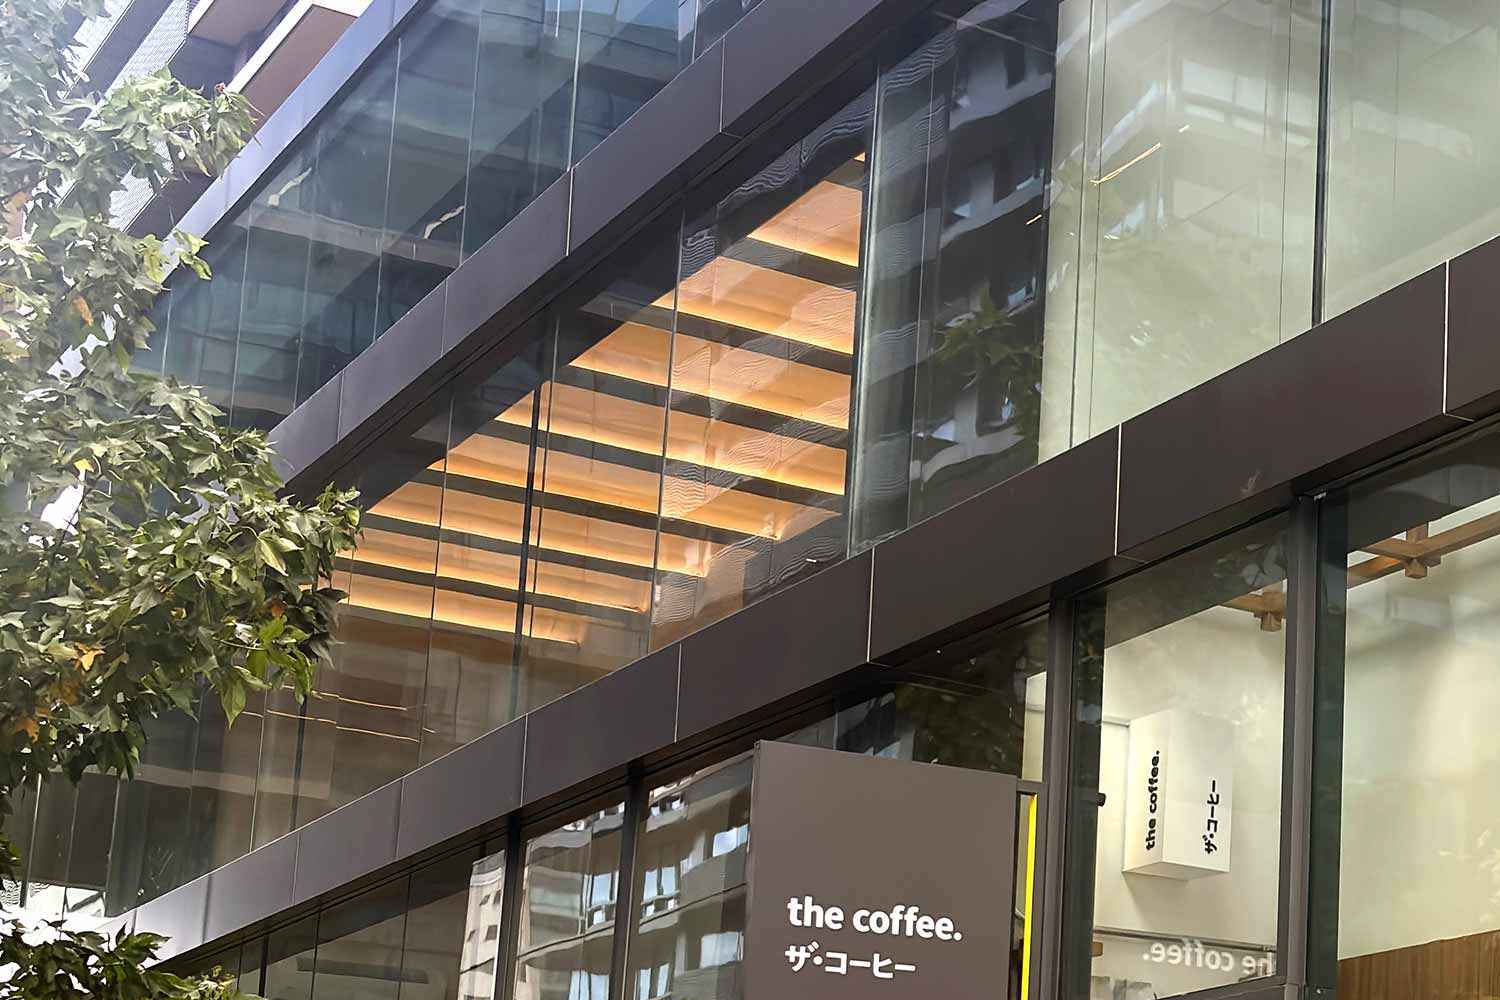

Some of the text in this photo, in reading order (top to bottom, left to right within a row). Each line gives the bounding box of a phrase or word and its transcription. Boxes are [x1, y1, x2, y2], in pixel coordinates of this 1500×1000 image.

[1145, 750, 1160, 851] the coffee.
[786, 895, 963, 942] the coffee.
[784, 940, 917, 979] ザ・コーヒー
